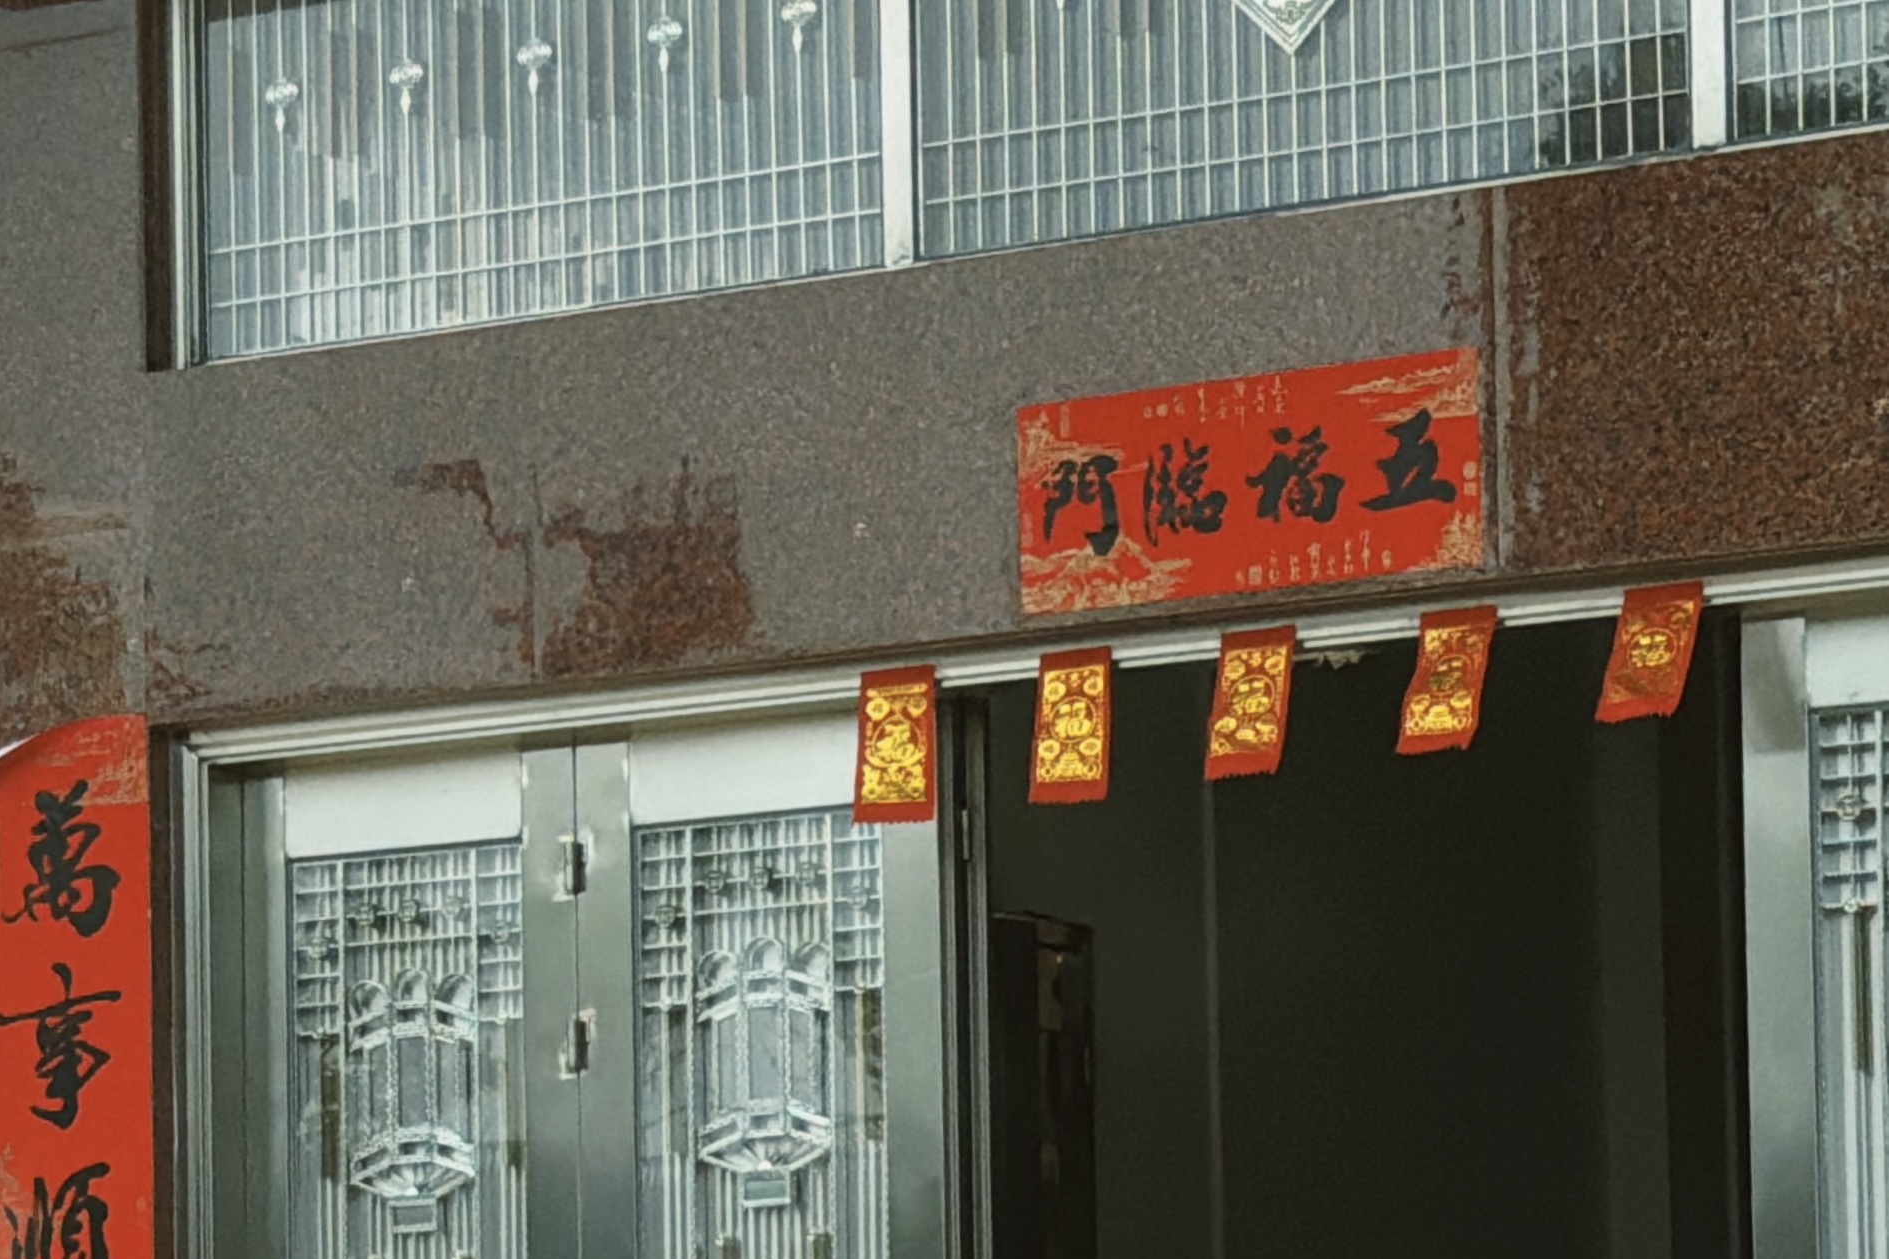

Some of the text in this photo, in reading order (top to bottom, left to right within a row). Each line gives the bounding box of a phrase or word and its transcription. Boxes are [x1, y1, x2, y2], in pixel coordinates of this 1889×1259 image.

[1041, 407, 1457, 556] 五福臨門
[1054, 702, 1092, 738] 福
